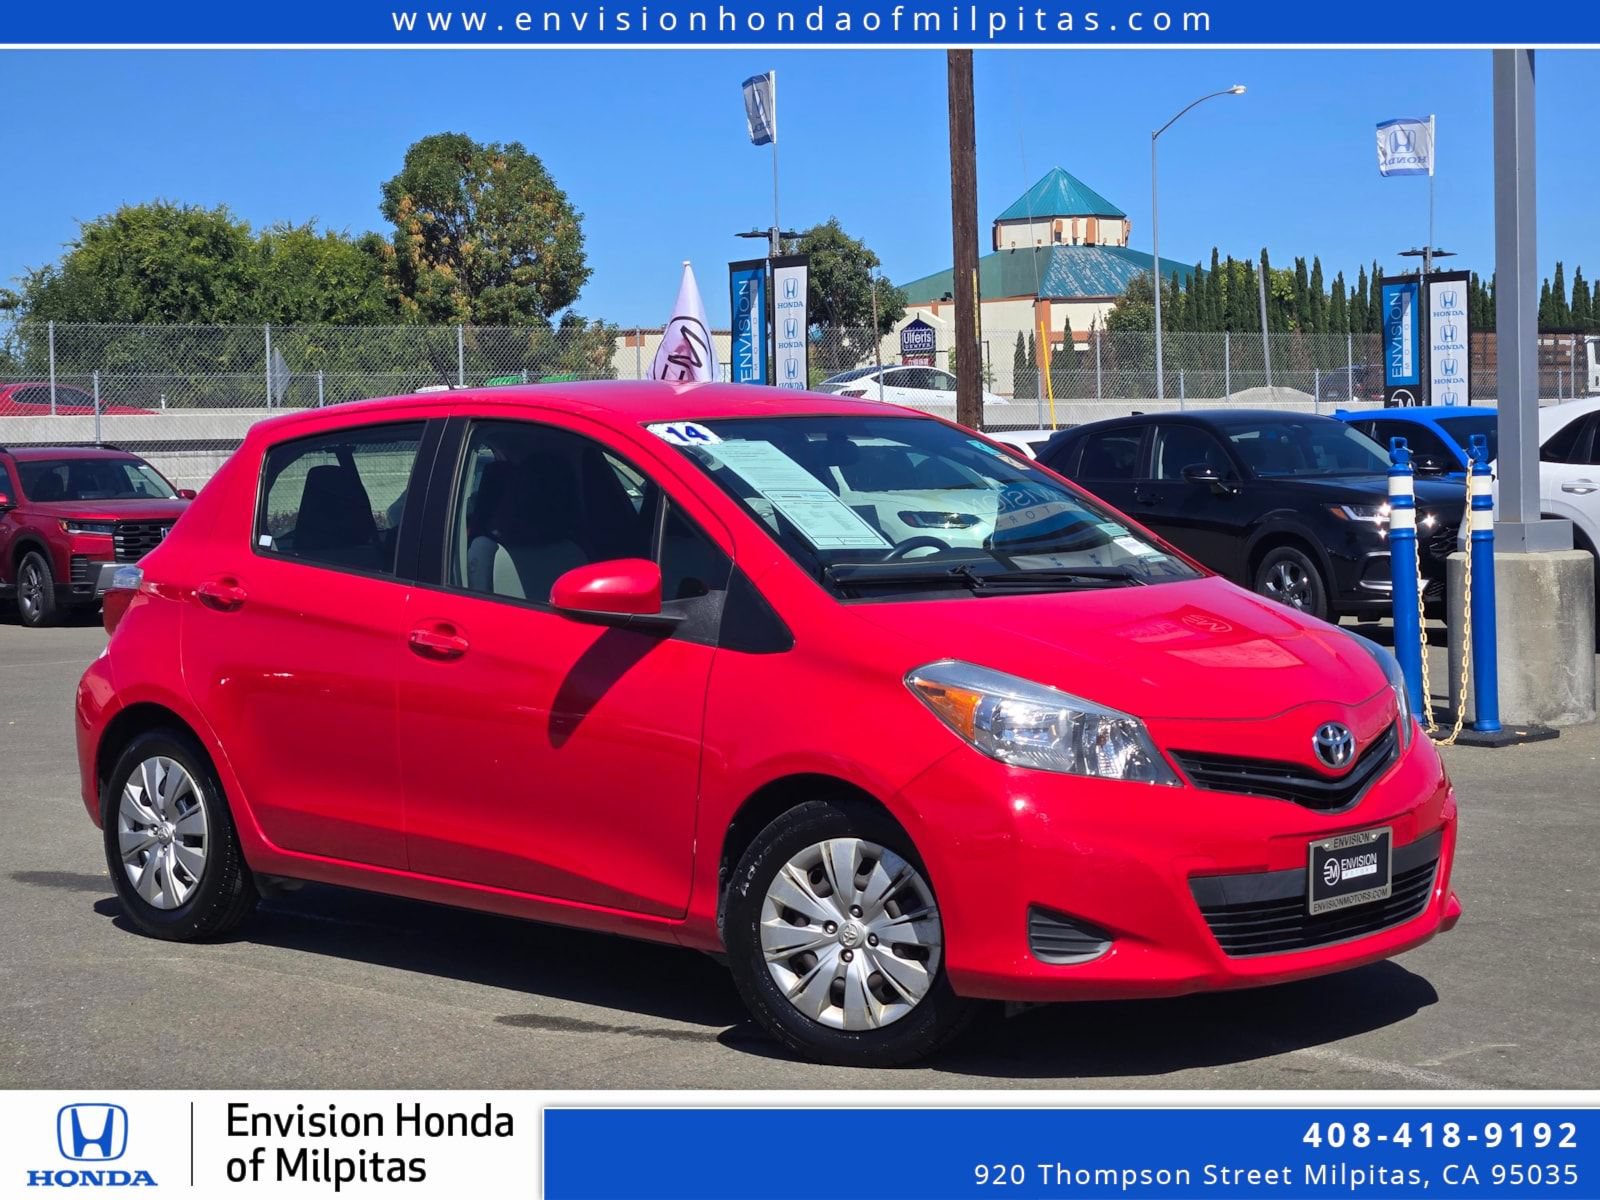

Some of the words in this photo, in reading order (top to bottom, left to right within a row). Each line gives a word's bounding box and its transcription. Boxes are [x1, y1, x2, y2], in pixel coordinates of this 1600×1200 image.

[777, 301, 804, 309] HONDA
[1433, 310, 1464, 318] HONDA
[739, 280, 753, 382] ENVISION
[1389, 292, 1403, 378] ENVISION
[778, 341, 804, 349] HONDA
[1433, 344, 1465, 352] HONDA
[1434, 377, 1465, 385] HONDA
[666, 425, 711, 442] 14
[1333, 832, 1370, 848] ENVISION
[1341, 853, 1377, 871] ENVISION
[1313, 888, 1388, 913] ENVISIONMOTORS.COM
